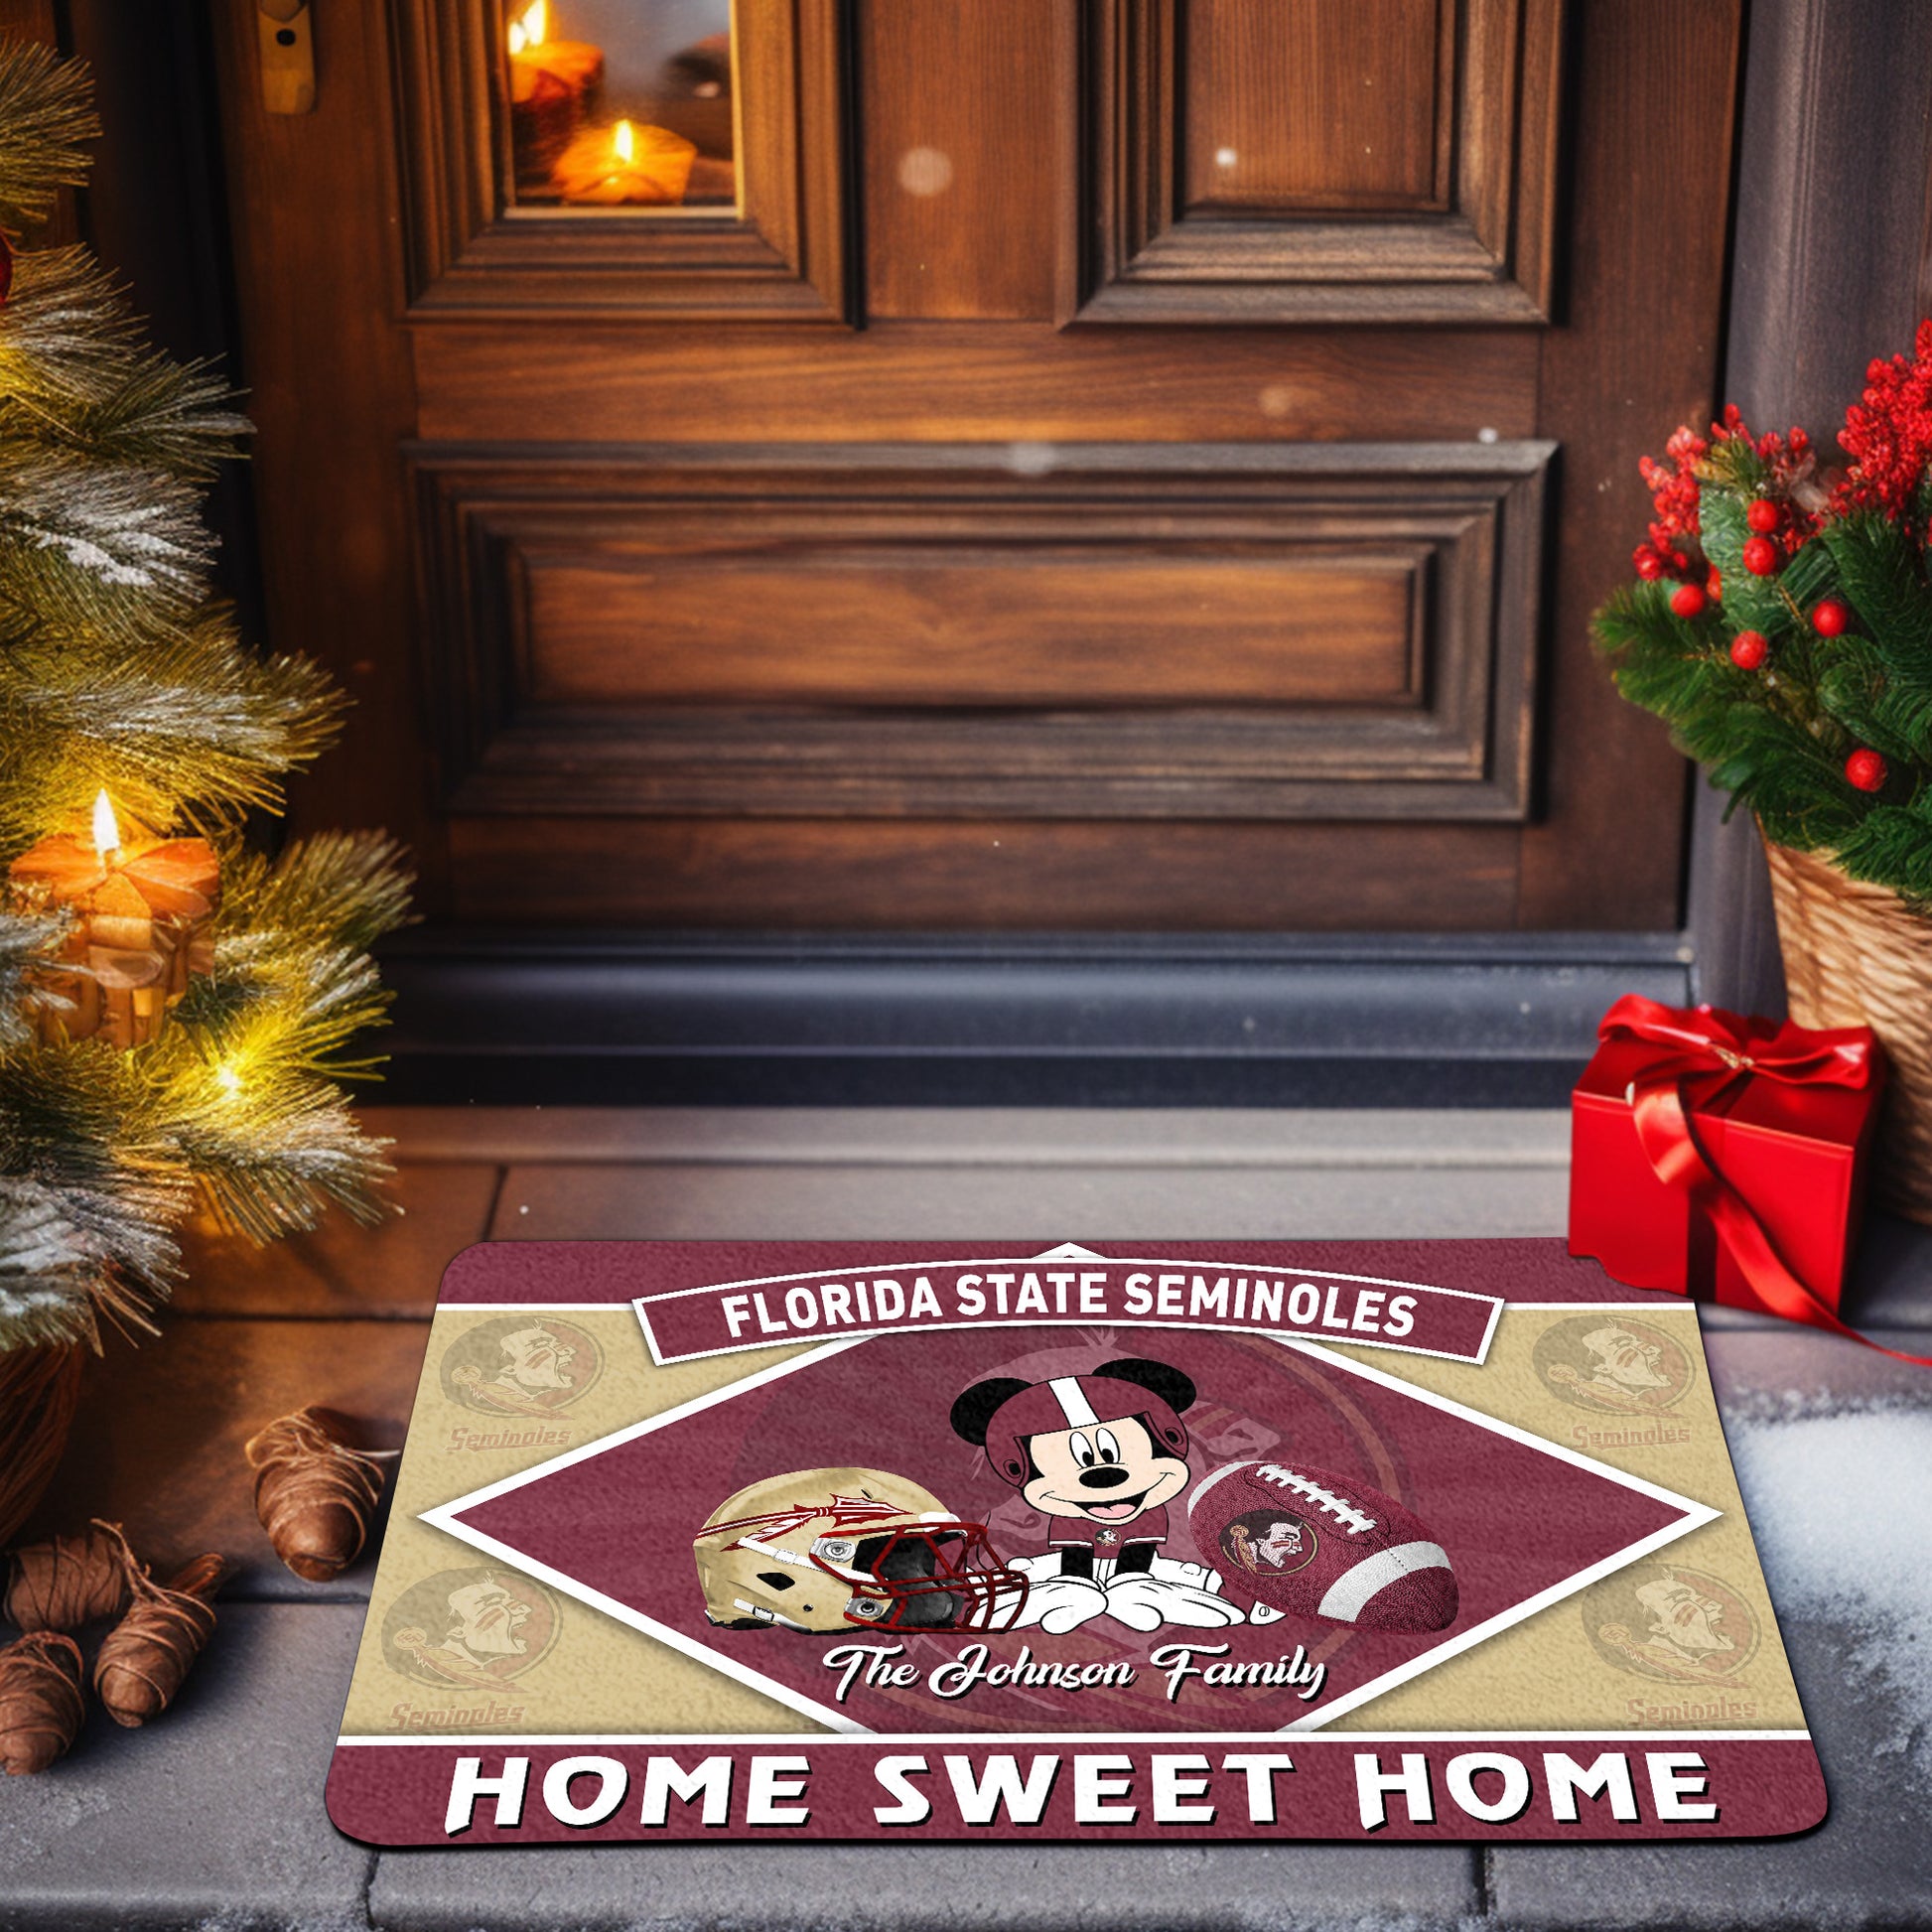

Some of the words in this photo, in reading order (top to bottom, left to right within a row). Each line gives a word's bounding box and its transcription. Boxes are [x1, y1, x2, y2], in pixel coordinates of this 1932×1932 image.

[721, 1276, 943, 1338] FLORIDA
[956, 1272, 1107, 1316] STATE
[1123, 1273, 1418, 1337] SEMINOLES
[445, 1426, 572, 1453] Seminoles
[1572, 1423, 1691, 1450] Seminoles
[822, 1643, 920, 1702] The
[927, 1643, 1137, 1699] Johnson
[1150, 1642, 1326, 1702] Family
[386, 1700, 525, 1731] Seminoles
[1627, 1696, 1757, 1726] Seminoles
[444, 1755, 812, 1835] HOME
[873, 1753, 1295, 1825] SWEET
[1353, 1751, 1720, 1830] HOME
